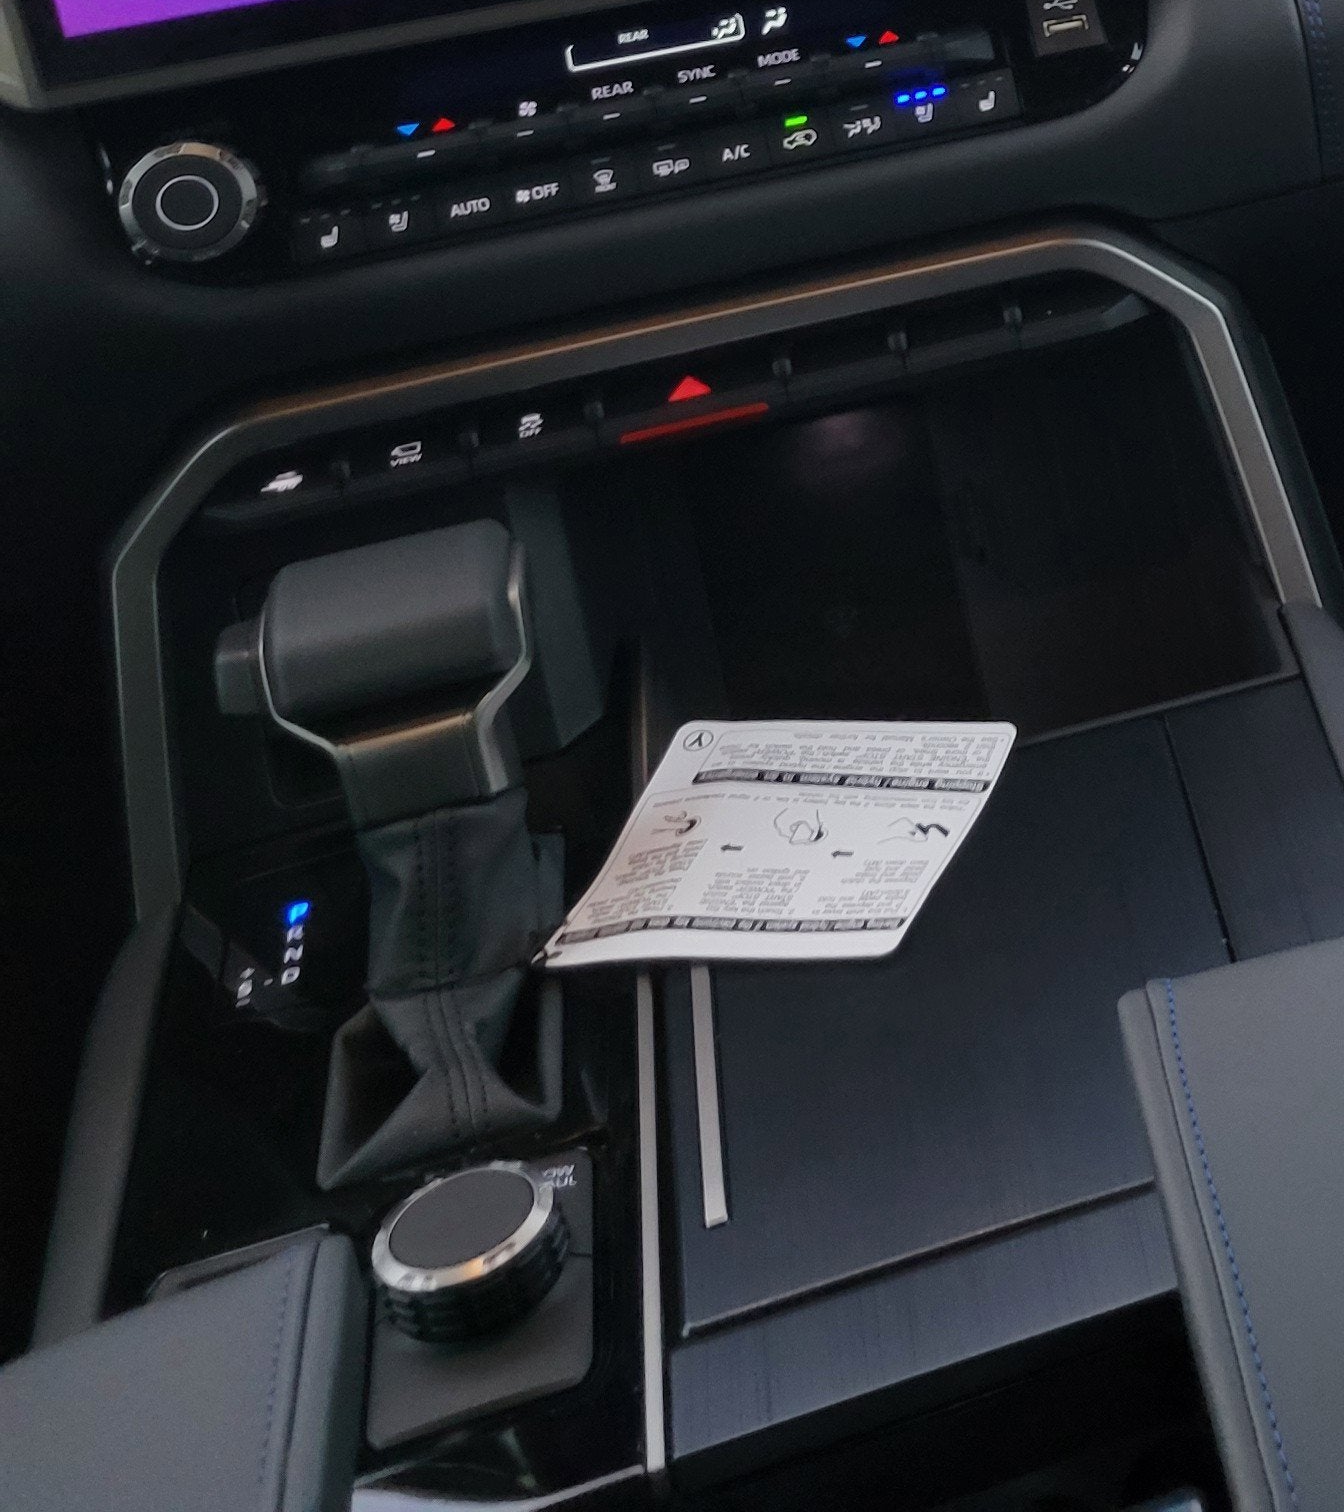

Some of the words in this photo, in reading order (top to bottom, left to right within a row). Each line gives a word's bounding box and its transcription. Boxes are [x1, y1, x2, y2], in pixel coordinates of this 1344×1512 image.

[617, 29, 649, 44] REAR
[756, 48, 801, 68] MODE
[677, 64, 717, 83] SYNC
[592, 80, 635, 100] REAR
[722, 144, 751, 162] A/C
[531, 182, 560, 201] OFF
[449, 197, 490, 219] AUTO
[389, 453, 423, 468] VIEW
[687, 732, 707, 750] Y
[283, 944, 304, 964] N
